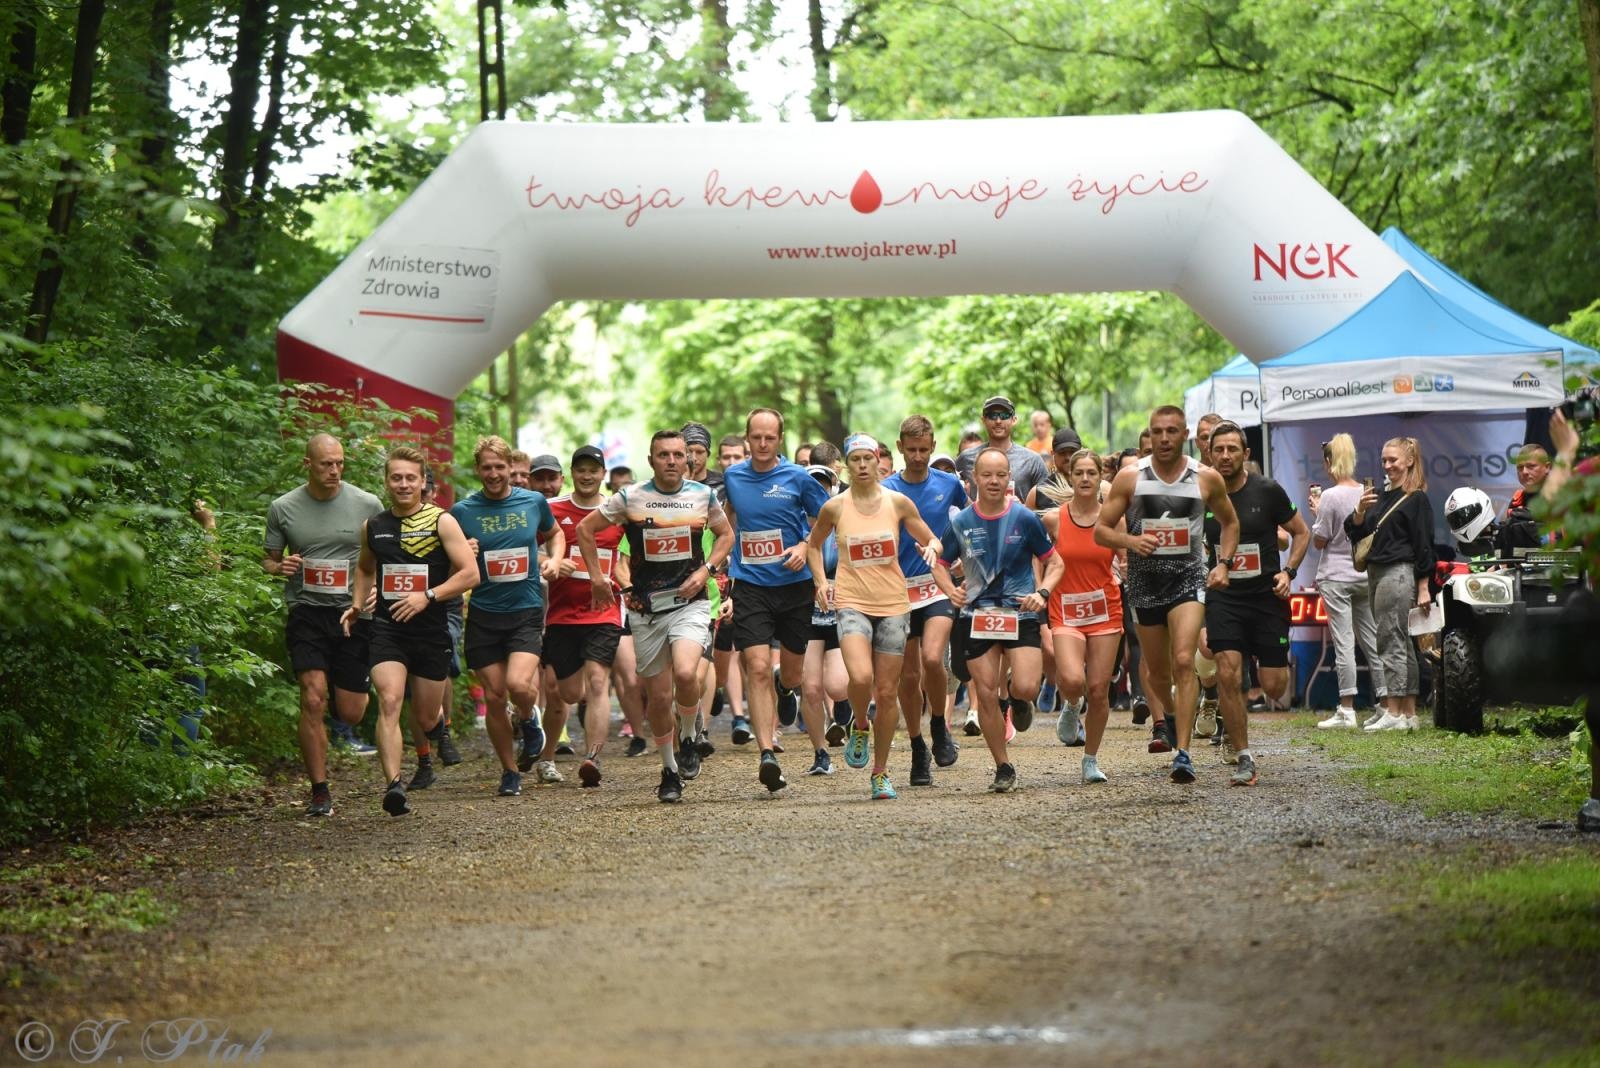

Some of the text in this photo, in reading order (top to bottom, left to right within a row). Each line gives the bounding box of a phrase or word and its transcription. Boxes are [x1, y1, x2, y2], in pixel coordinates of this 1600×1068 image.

[525, 169, 1209, 227] twoja krew moje życie
[767, 239, 957, 261] www.twojakrew.pl
[368, 255, 492, 279] Ministerstwo
[361, 278, 440, 299] Zdrowia
[1282, 380, 1387, 401] PersonalBest
[1512, 379, 1540, 389] MITKO
[480, 510, 528, 534] RUN
[657, 538, 678, 554] 22
[1156, 531, 1177, 546] 31
[747, 541, 776, 557] 100
[862, 543, 884, 558] 83
[498, 559, 519, 574] 79
[315, 571, 335, 586] 15
[393, 576, 414, 591] 55
[919, 584, 938, 600] 59
[1075, 602, 1096, 618] 51
[984, 616, 1005, 631] 32
